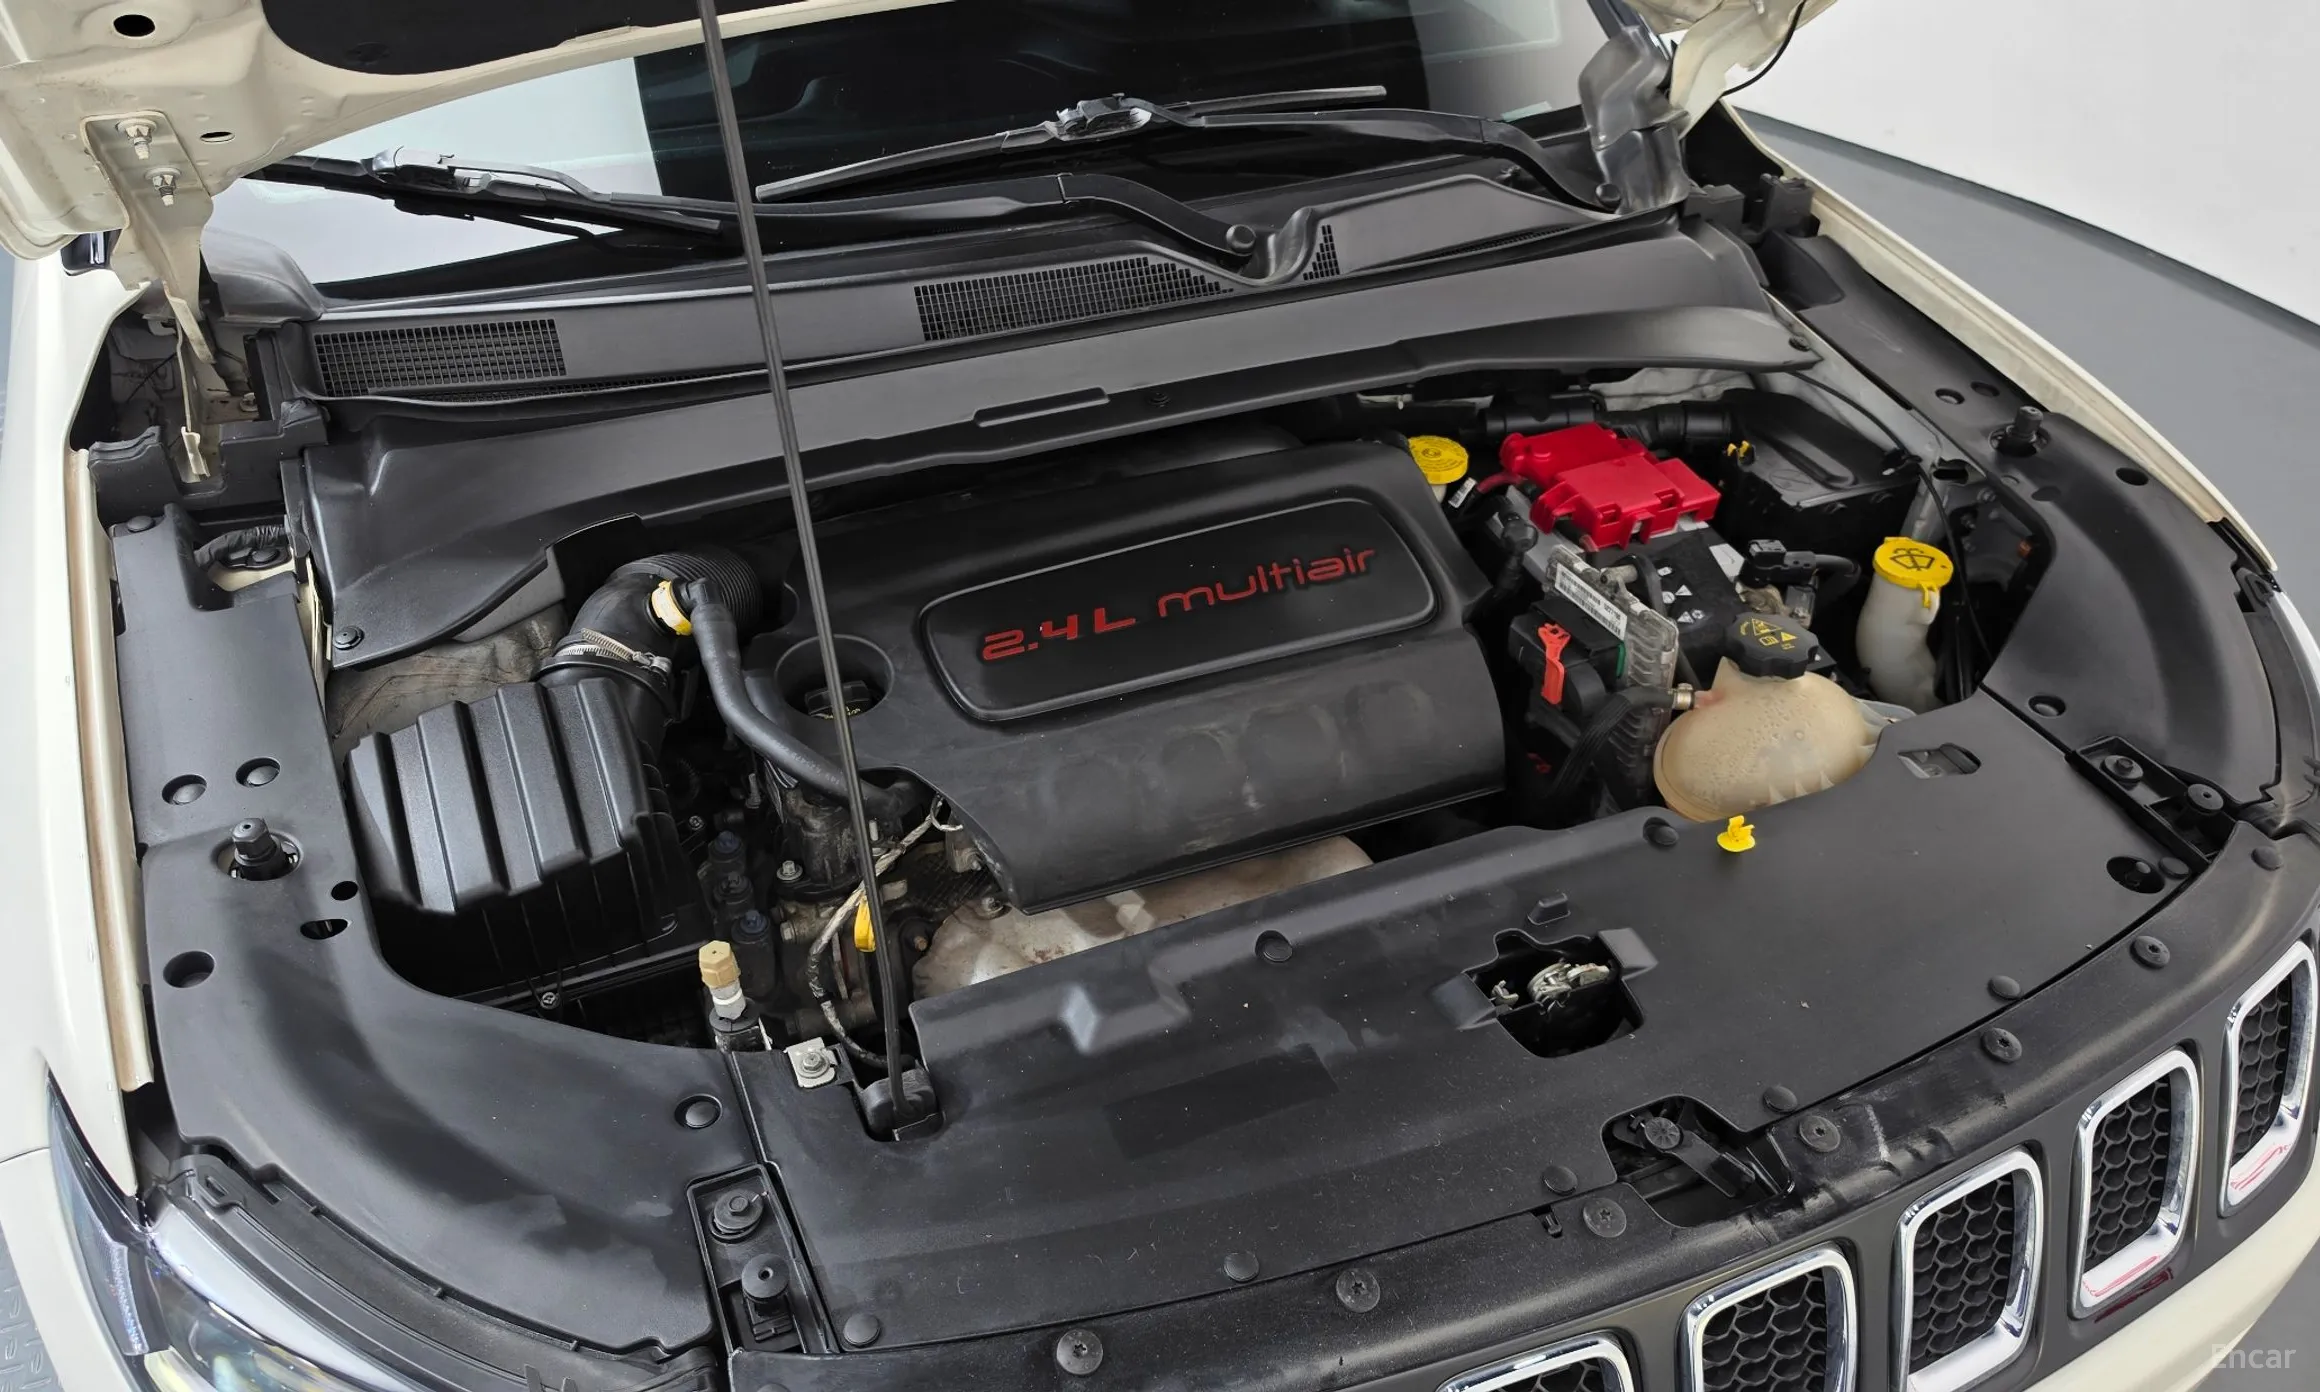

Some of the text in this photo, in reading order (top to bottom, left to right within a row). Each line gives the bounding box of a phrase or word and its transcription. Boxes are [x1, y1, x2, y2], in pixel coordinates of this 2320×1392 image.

[982, 548, 1376, 662] 2.4 L multiair
